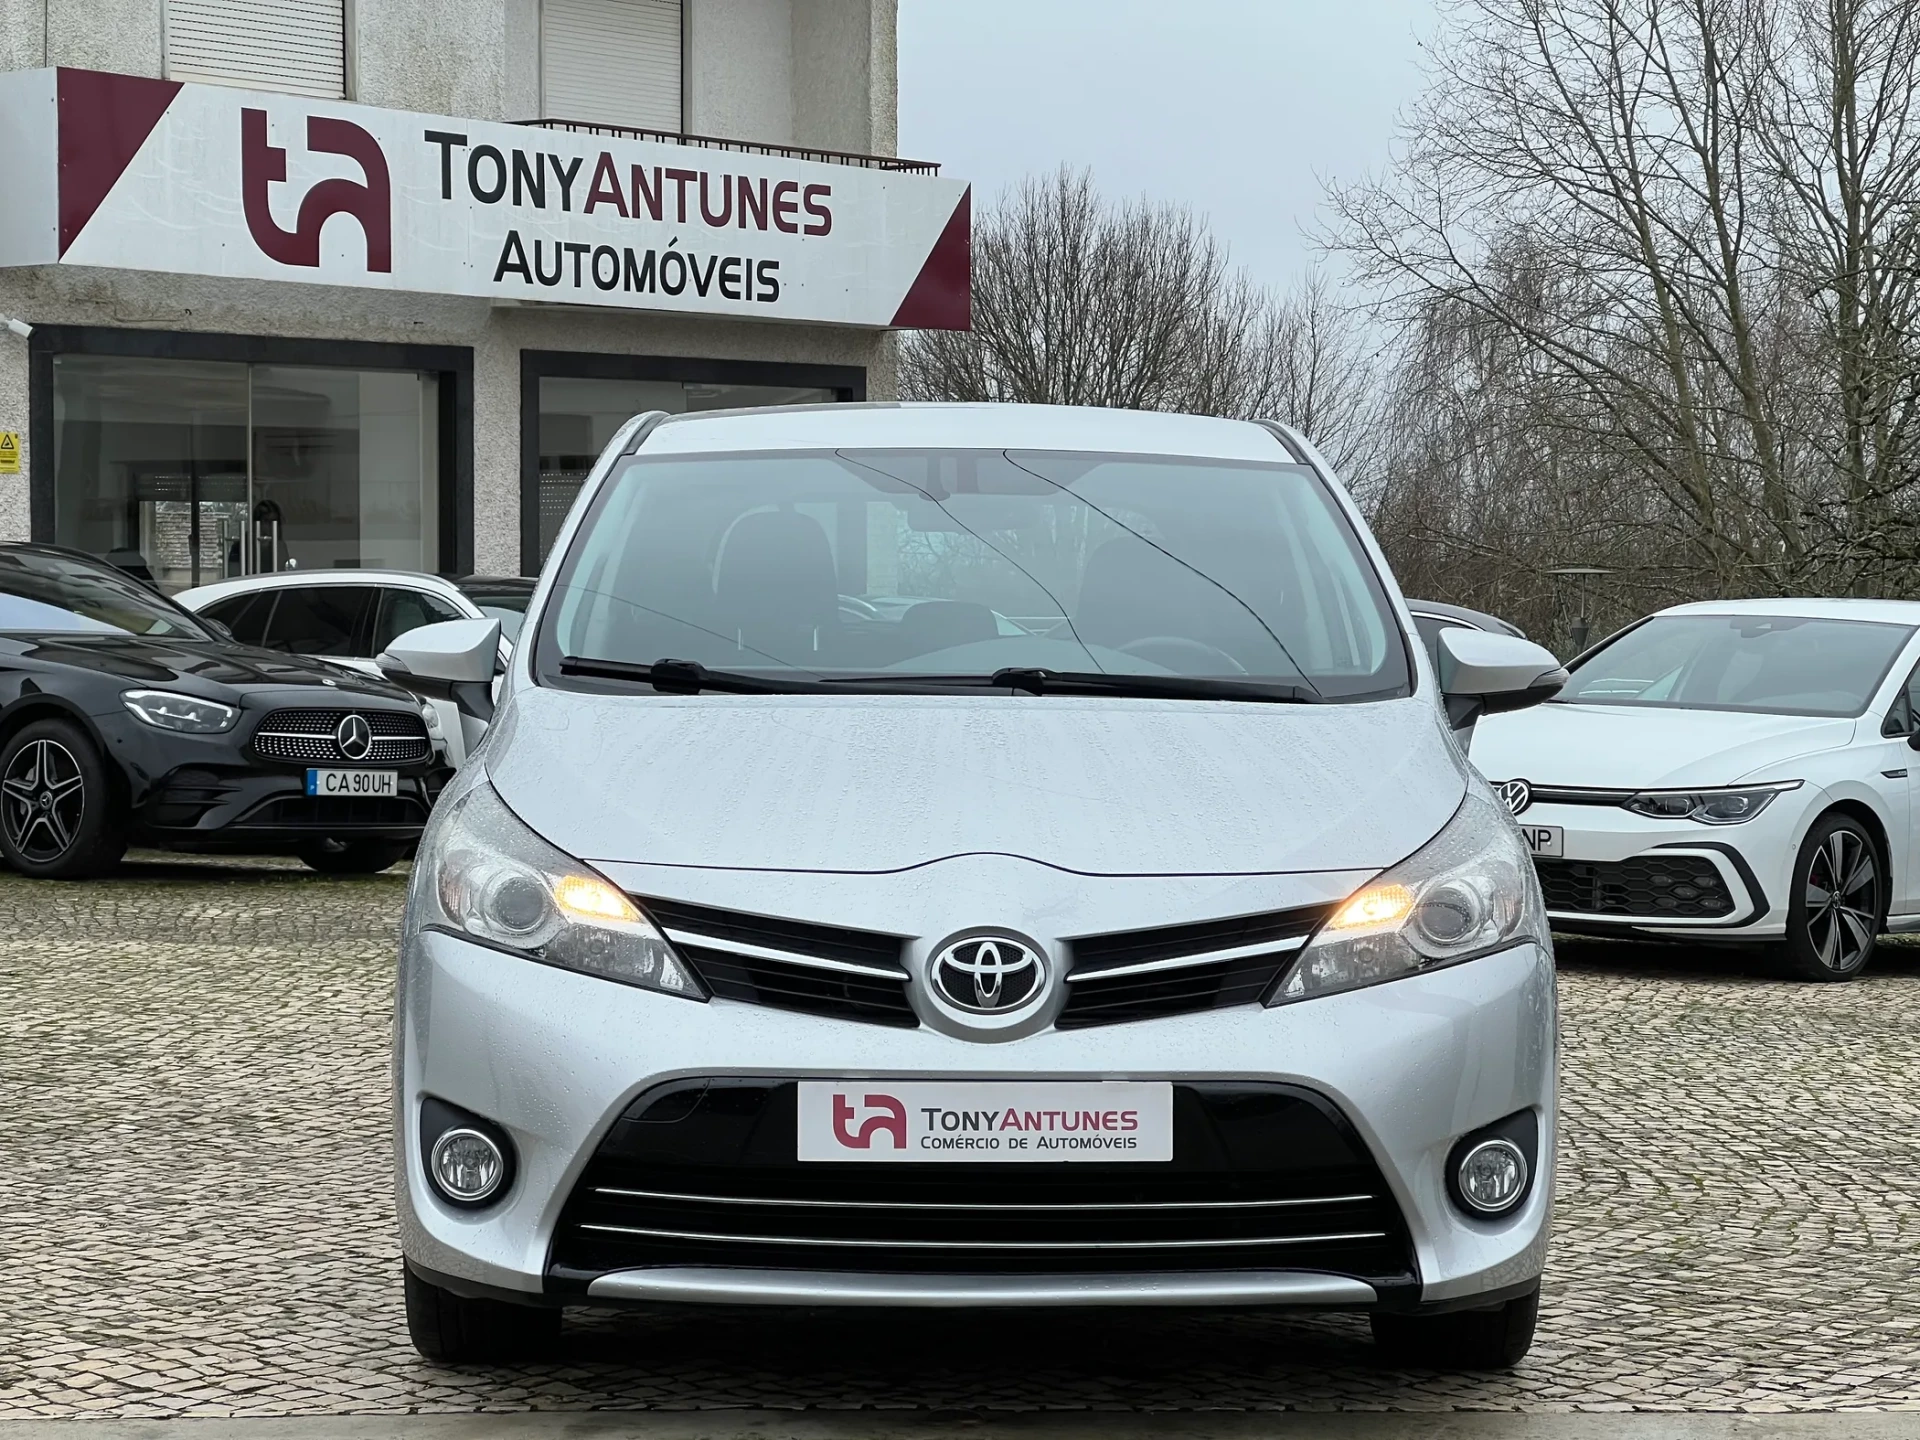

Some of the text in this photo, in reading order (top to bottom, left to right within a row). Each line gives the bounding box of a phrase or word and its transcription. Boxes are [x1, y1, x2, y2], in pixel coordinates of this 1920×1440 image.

[493, 229, 780, 304] AUTOMÓVEIS
[325, 773, 392, 794] CA 90 UH
[920, 1133, 1137, 1150] COMÉRCIO DE AUTOMÓVEIS
